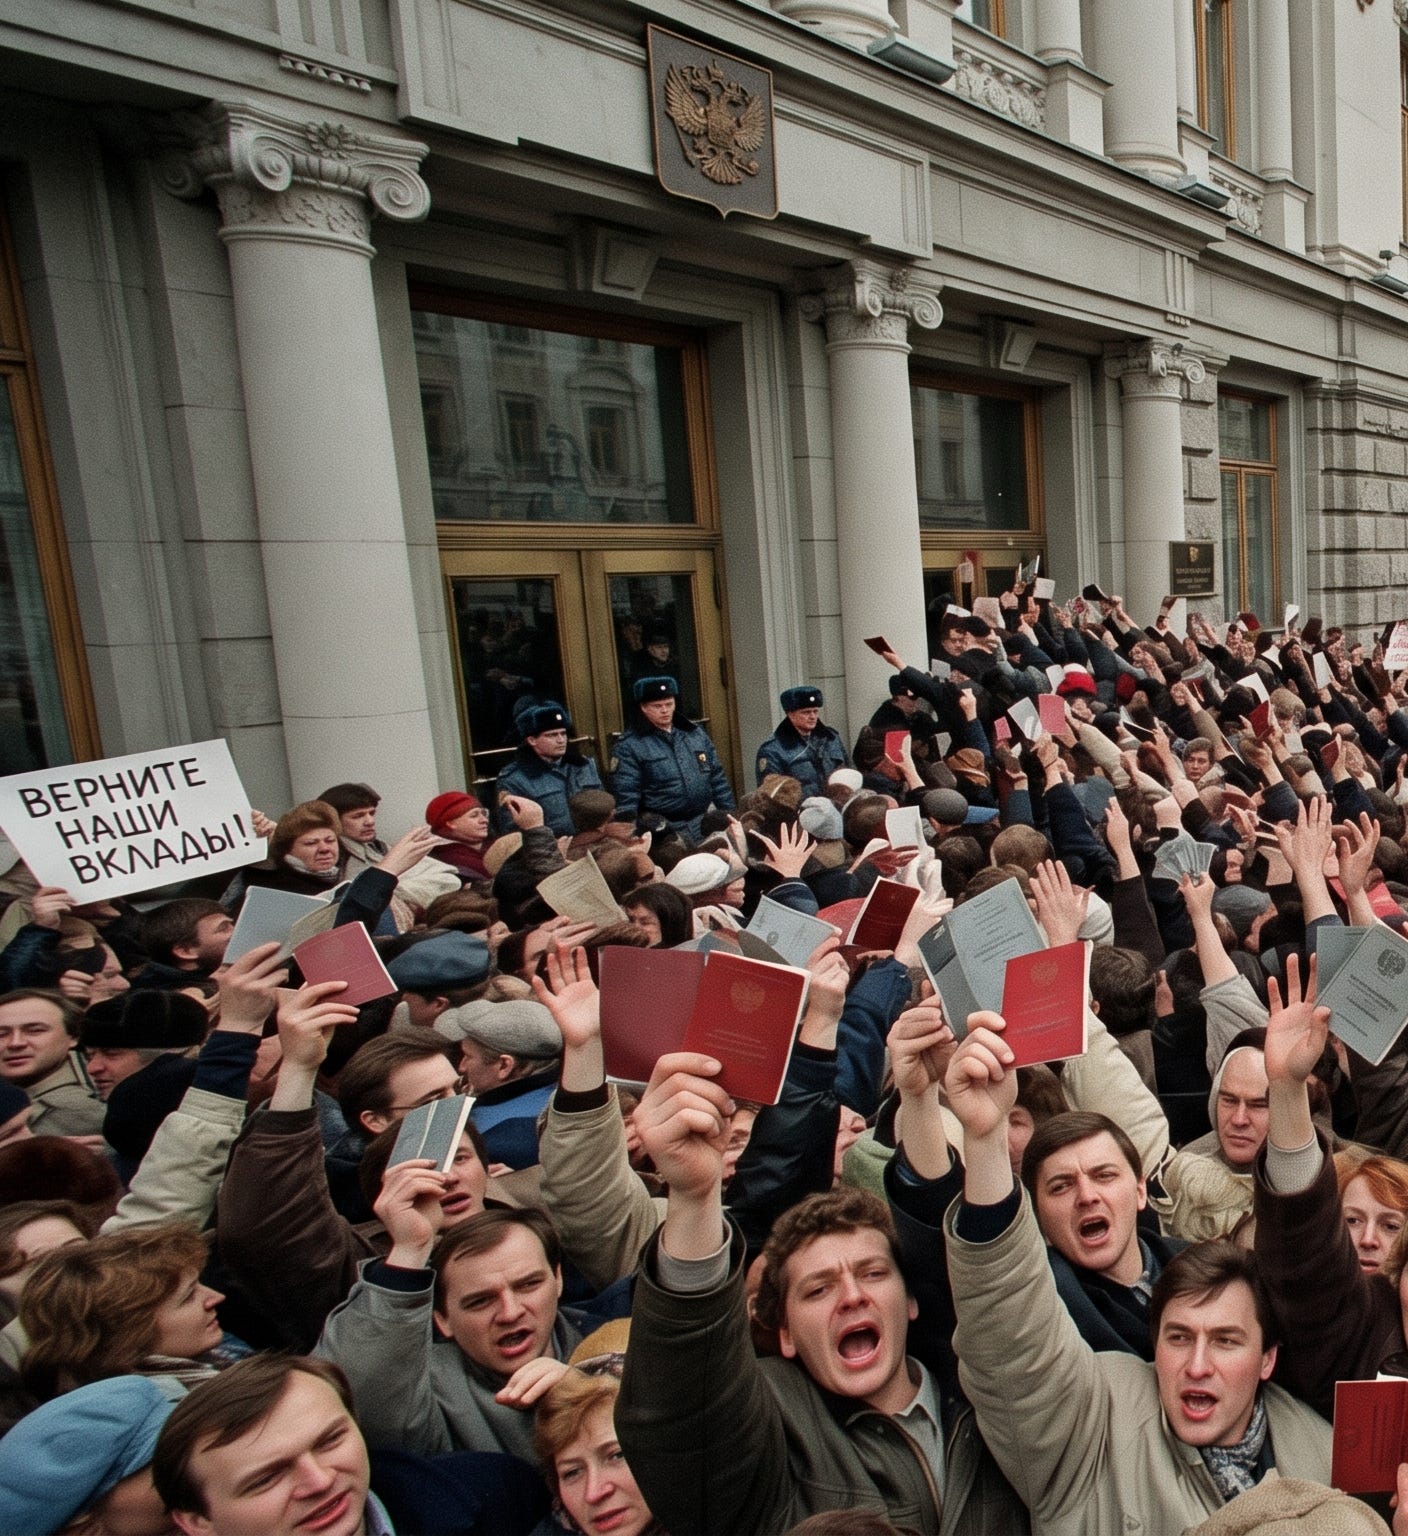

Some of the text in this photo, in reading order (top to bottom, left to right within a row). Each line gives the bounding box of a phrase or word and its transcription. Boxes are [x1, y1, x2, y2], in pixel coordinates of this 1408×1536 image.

[18, 757, 206, 818] ВЕРНИТЕ
[56, 800, 179, 849] НАШИ
[69, 814, 250, 884] ВКЛАДЫ!
